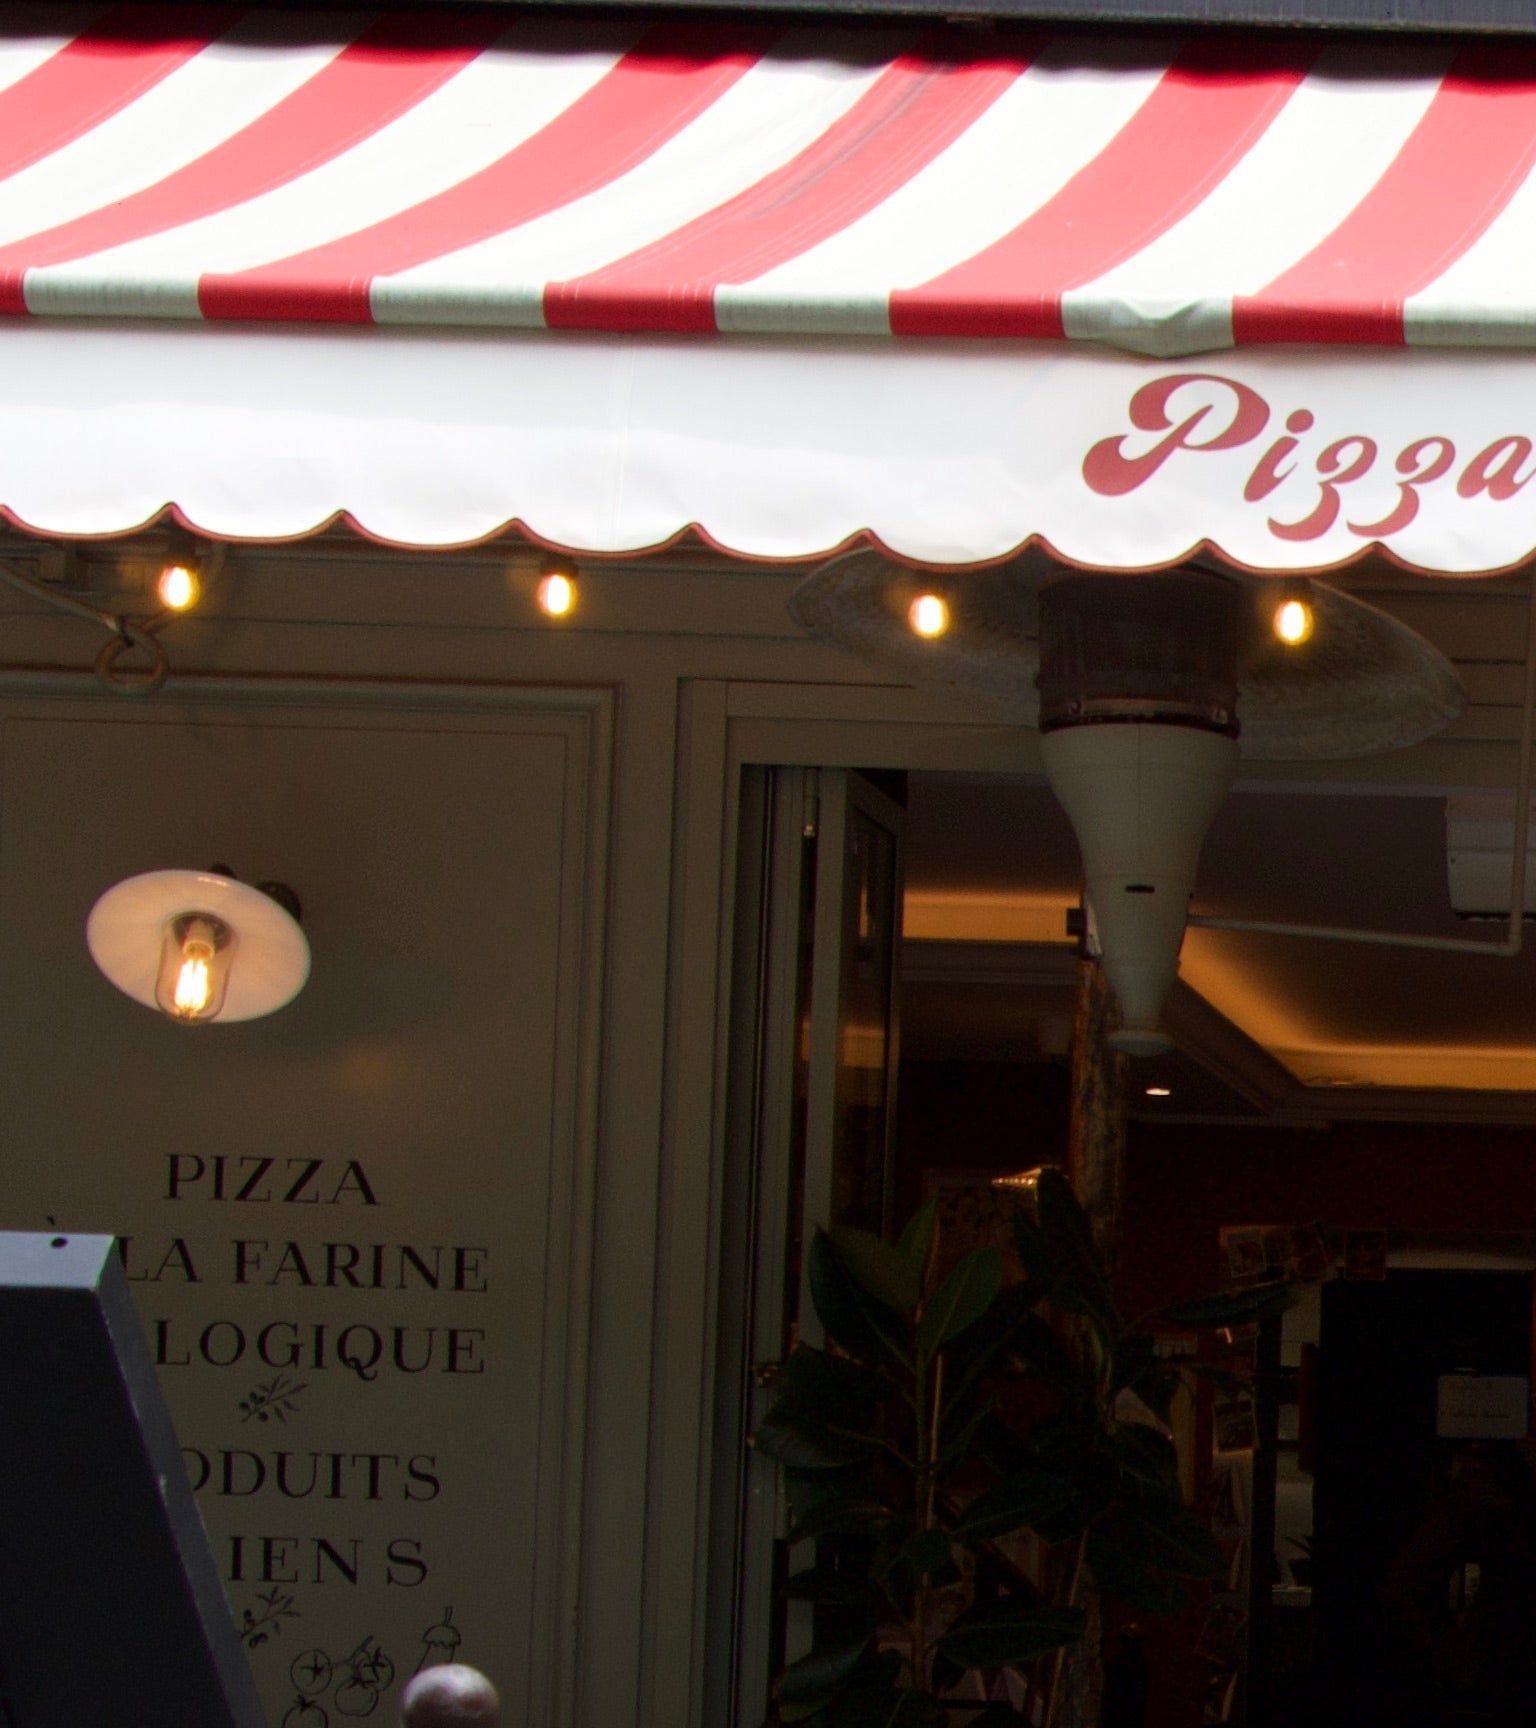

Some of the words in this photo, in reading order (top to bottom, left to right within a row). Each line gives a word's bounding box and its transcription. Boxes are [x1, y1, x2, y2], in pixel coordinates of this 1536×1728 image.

[163, 1152, 382, 1207] PIZZA
[231, 1239, 488, 1293] FARINE
[153, 1318, 486, 1383] LOGIQUE
[179, 1448, 441, 1502] ODUITS
[226, 1535, 429, 1588] IENS
